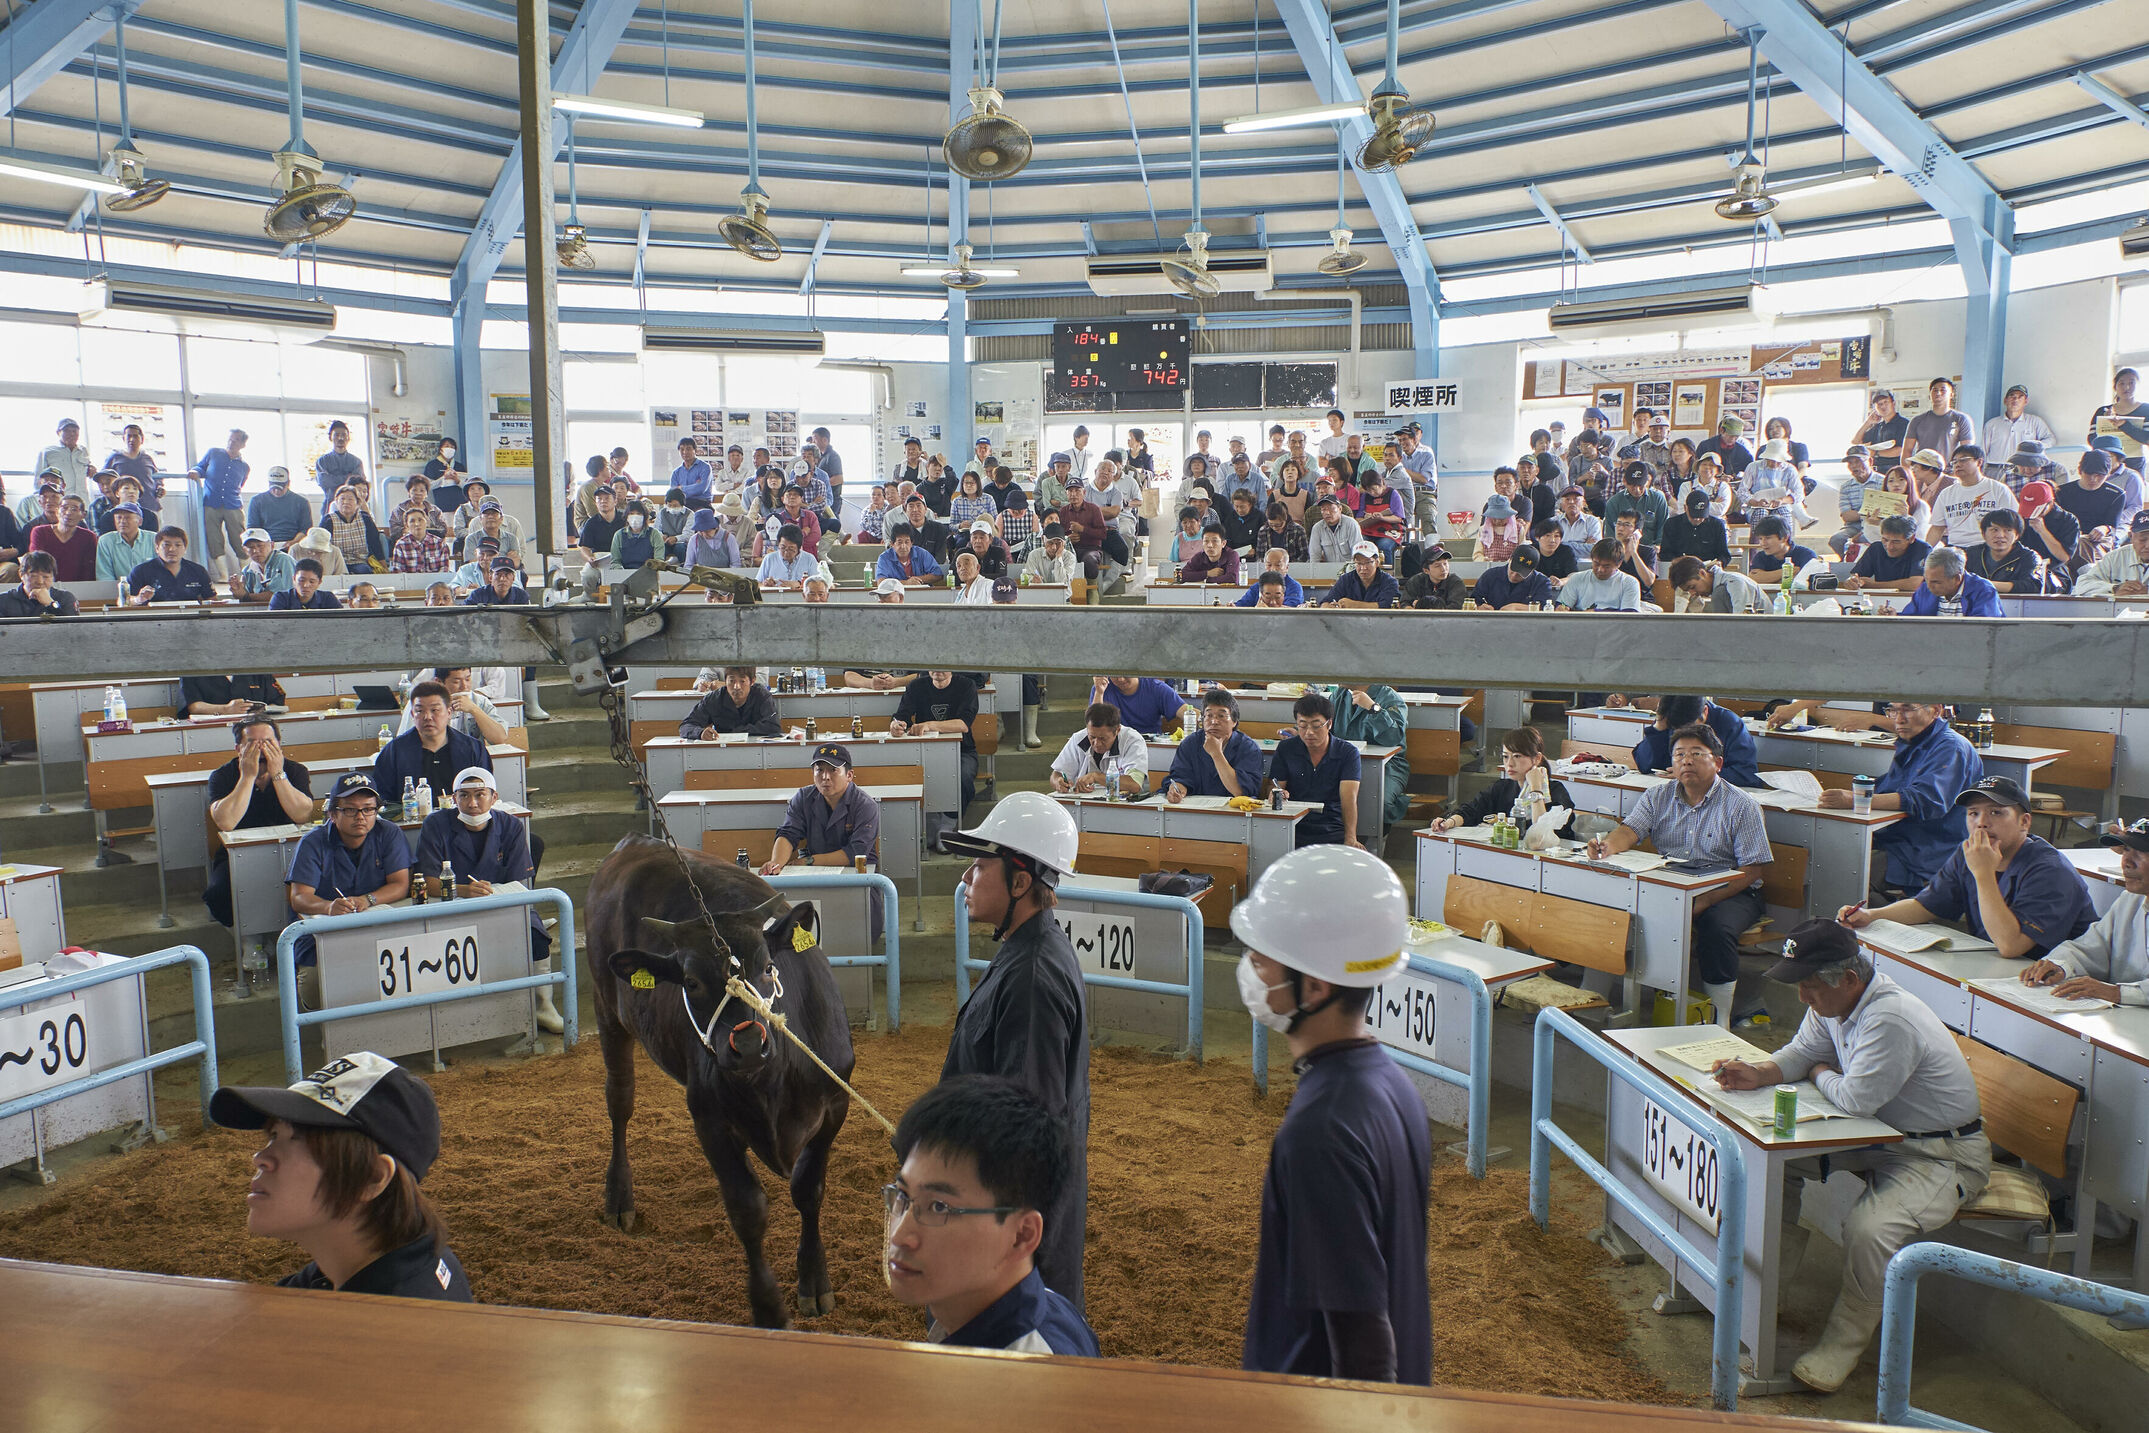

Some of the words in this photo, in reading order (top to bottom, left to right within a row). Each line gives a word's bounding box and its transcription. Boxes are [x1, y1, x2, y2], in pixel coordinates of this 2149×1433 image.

[1074, 333, 1099, 345] 184
[1070, 375, 1099, 388] 357
[1143, 369, 1179, 385] 742
[1390, 384, 1457, 409] 喫煙所
[377, 421, 412, 438] 宮崎牛
